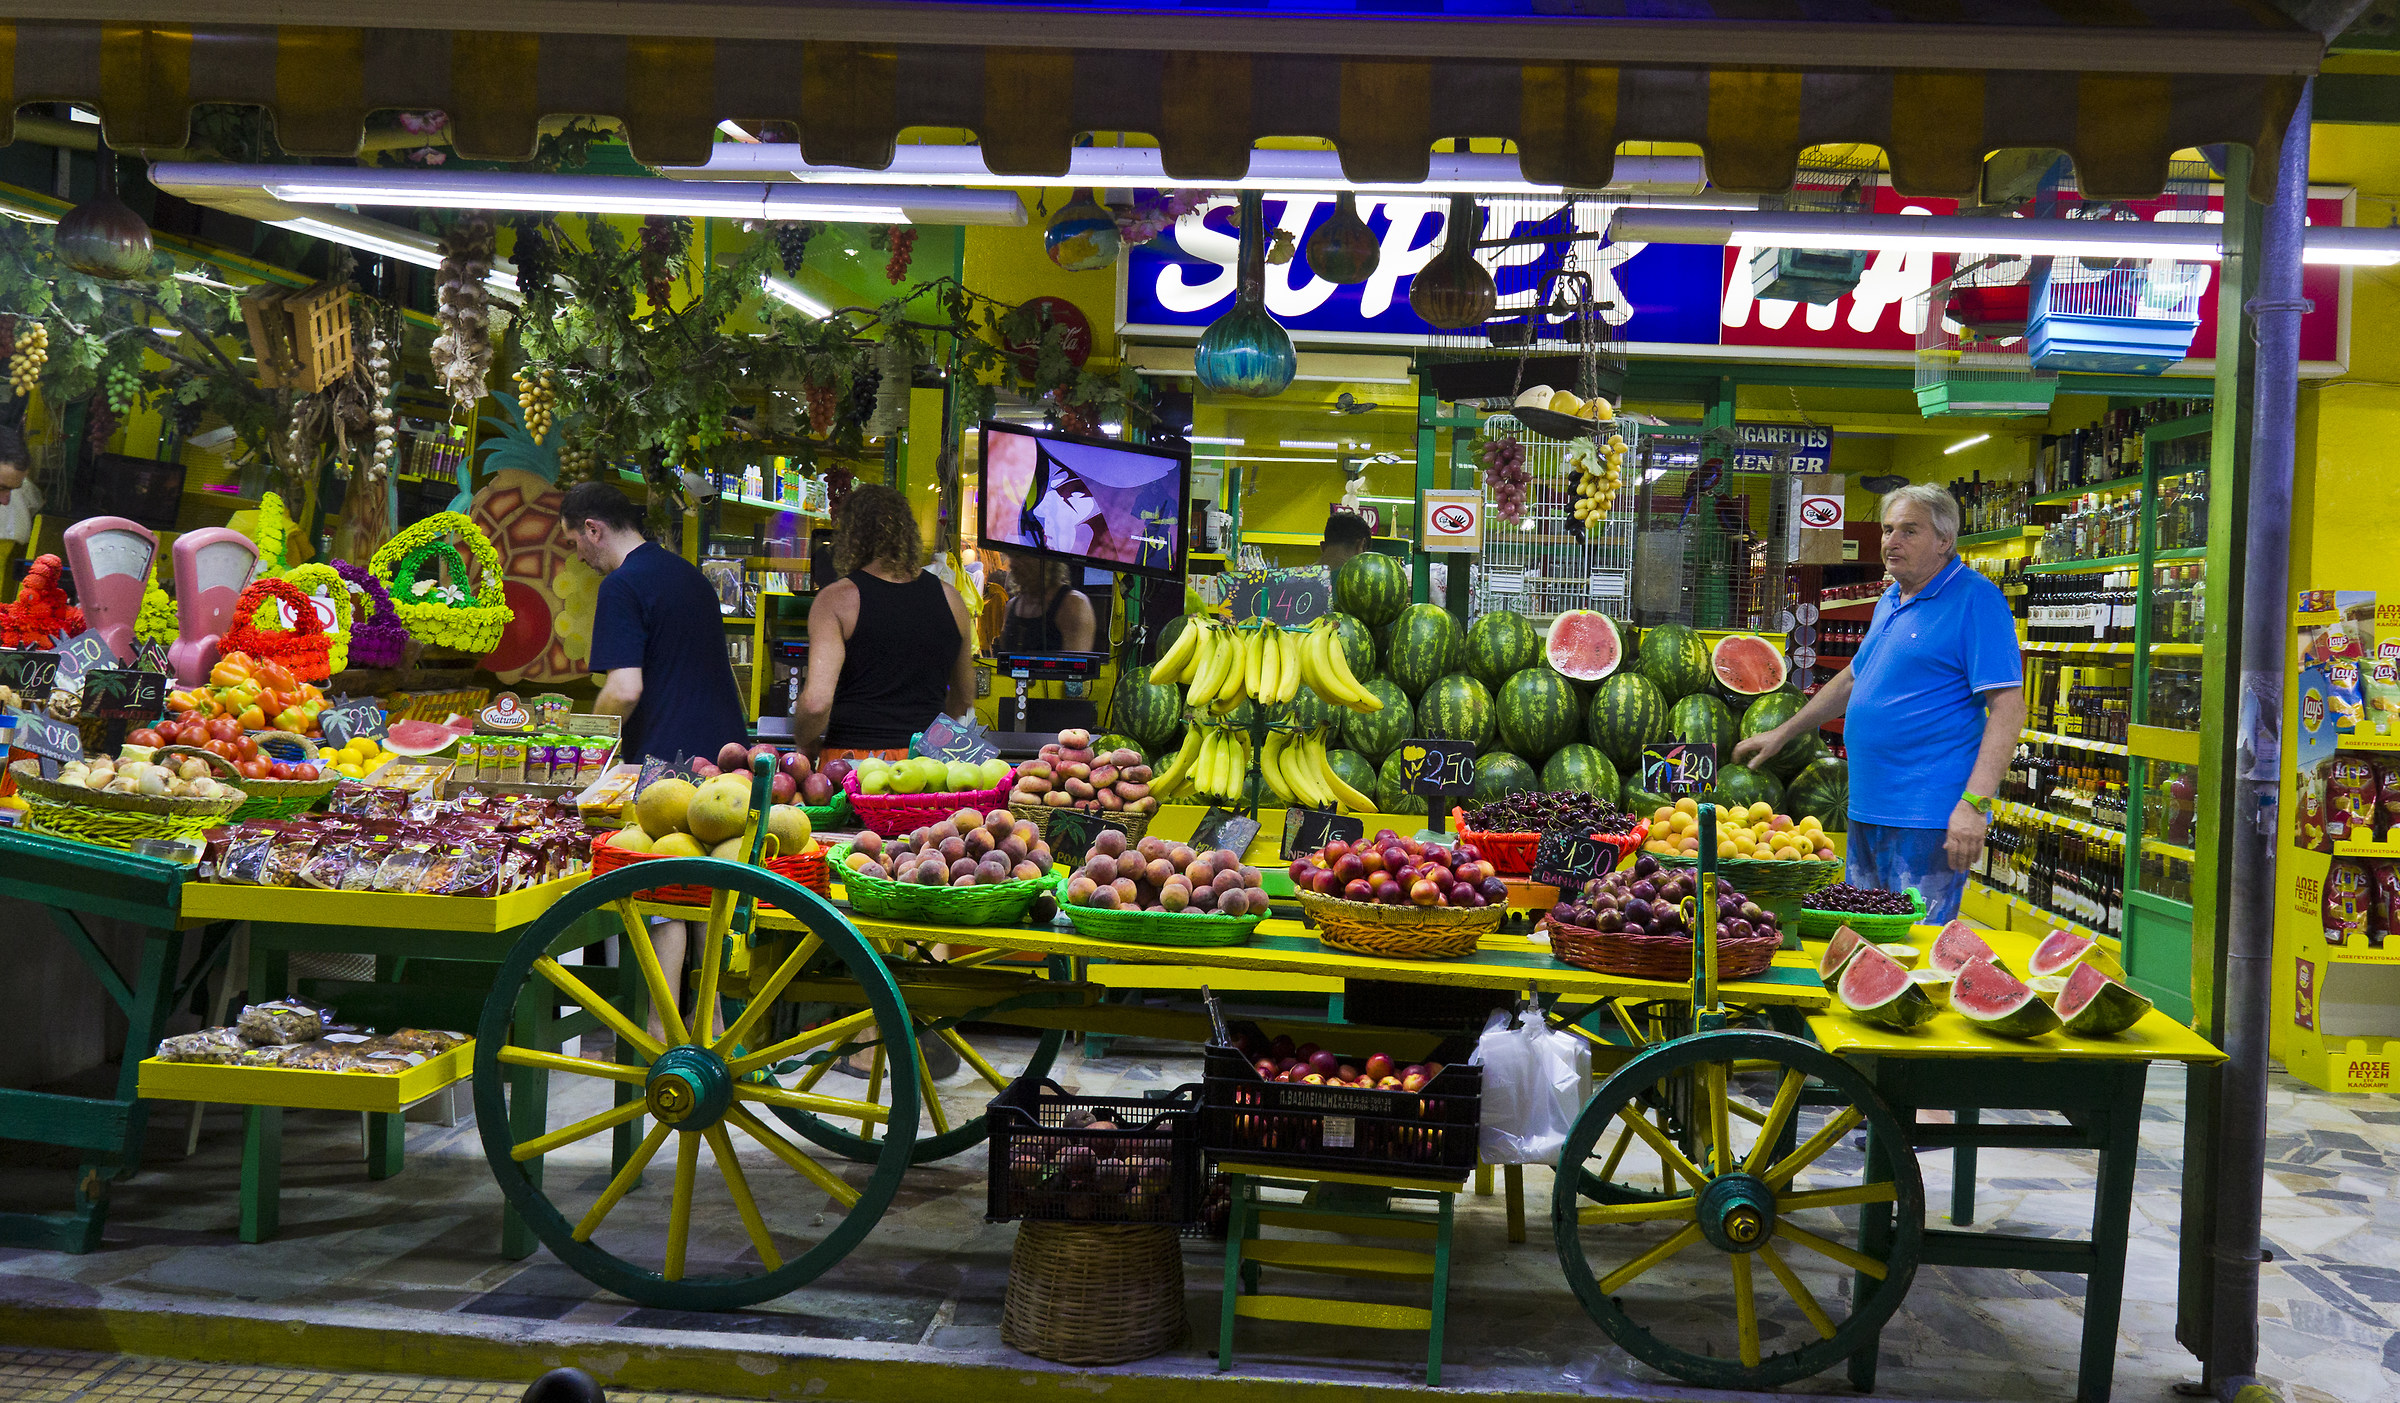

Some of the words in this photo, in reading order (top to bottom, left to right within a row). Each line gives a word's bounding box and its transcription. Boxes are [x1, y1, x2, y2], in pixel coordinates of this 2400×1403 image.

[1155, 193, 1636, 327] SUPER
[2377, 604, 2400, 612] ΔΩΣ
[488, 713, 525, 724] Naturals
[2296, 875, 2319, 891] ΔΩΣΕ
[2295, 888, 2318, 904] ΓΕΥΣΗ
[2348, 1061, 2390, 1070] ΔΩΣΕ
